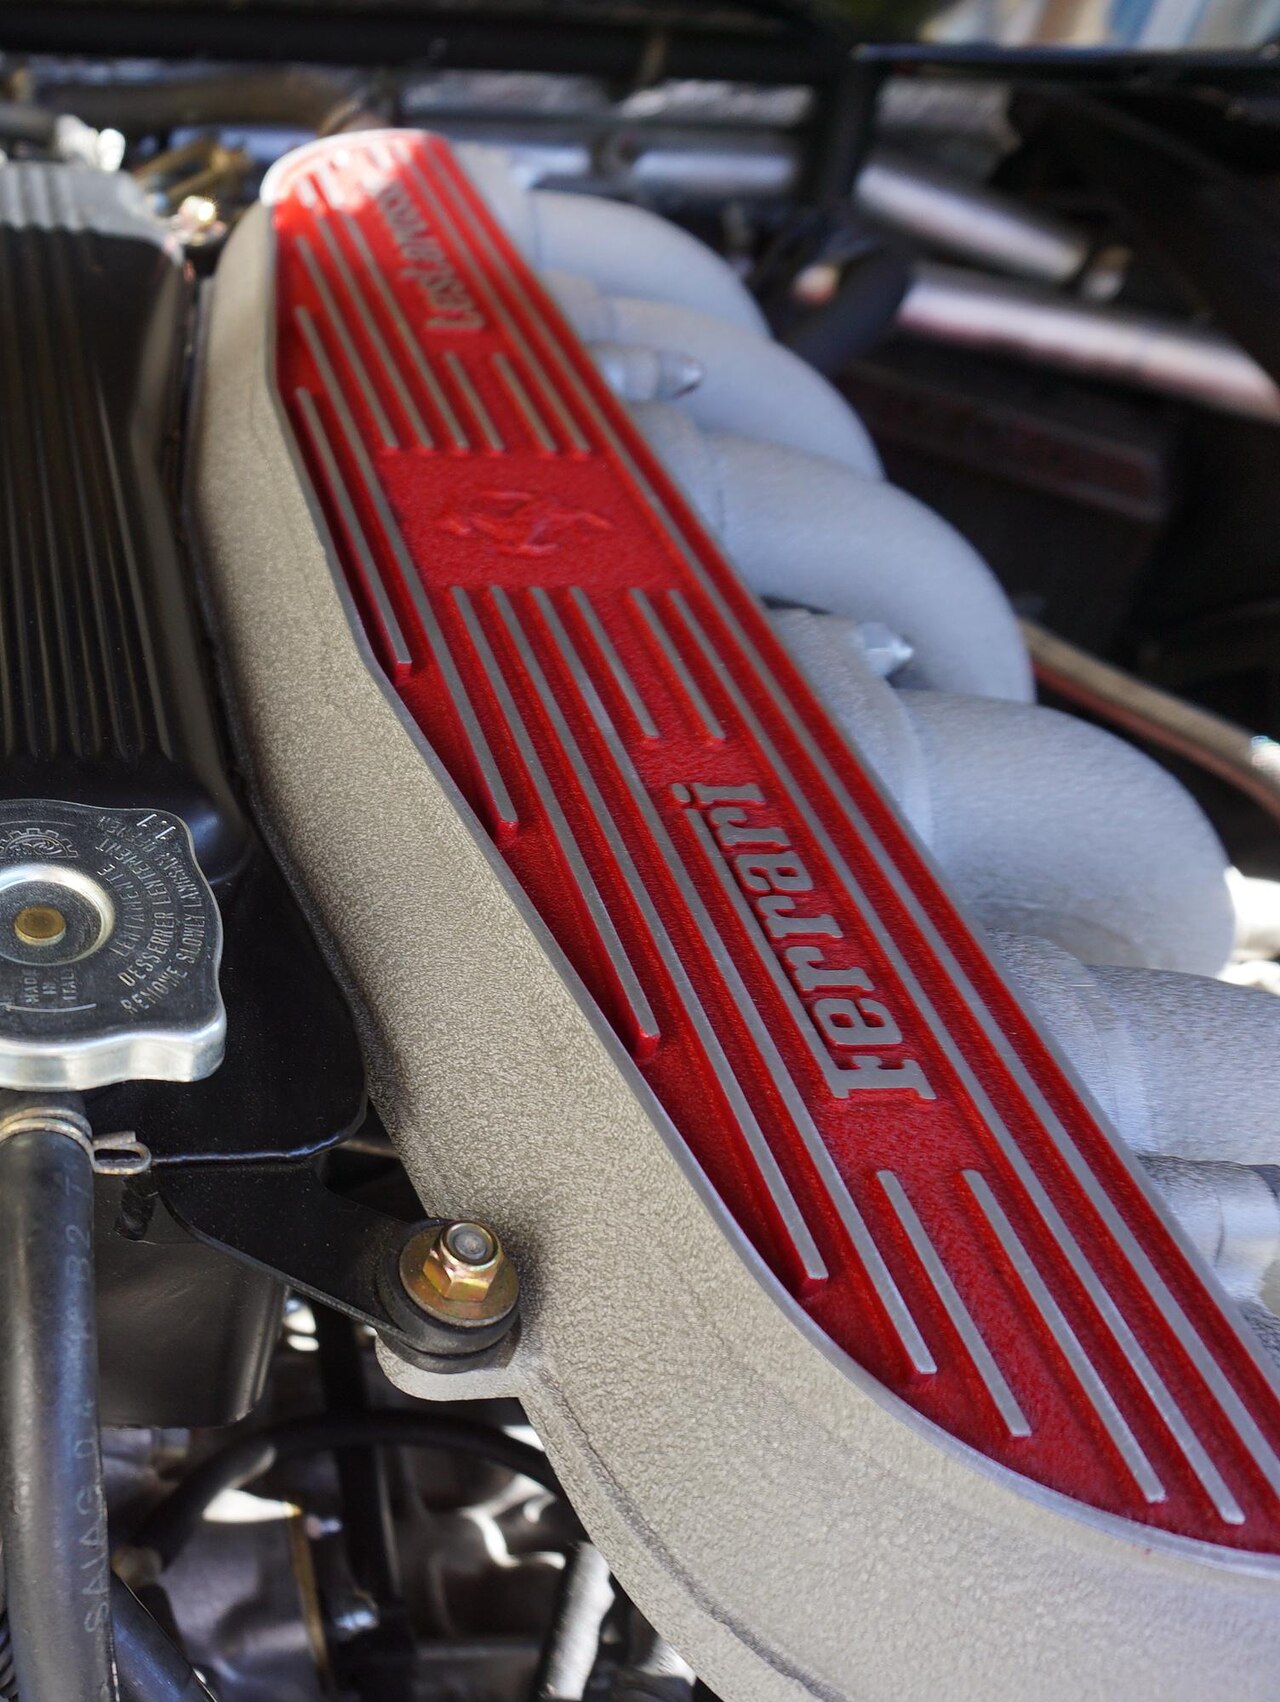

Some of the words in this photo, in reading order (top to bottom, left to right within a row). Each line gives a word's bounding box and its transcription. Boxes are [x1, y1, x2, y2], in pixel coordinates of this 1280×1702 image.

[118, 911, 174, 987] DESSERRER
[120, 964, 188, 1014] REMOVE
[175, 912, 206, 964] SLOWLY
[671, 782, 937, 1100] Ferrari
